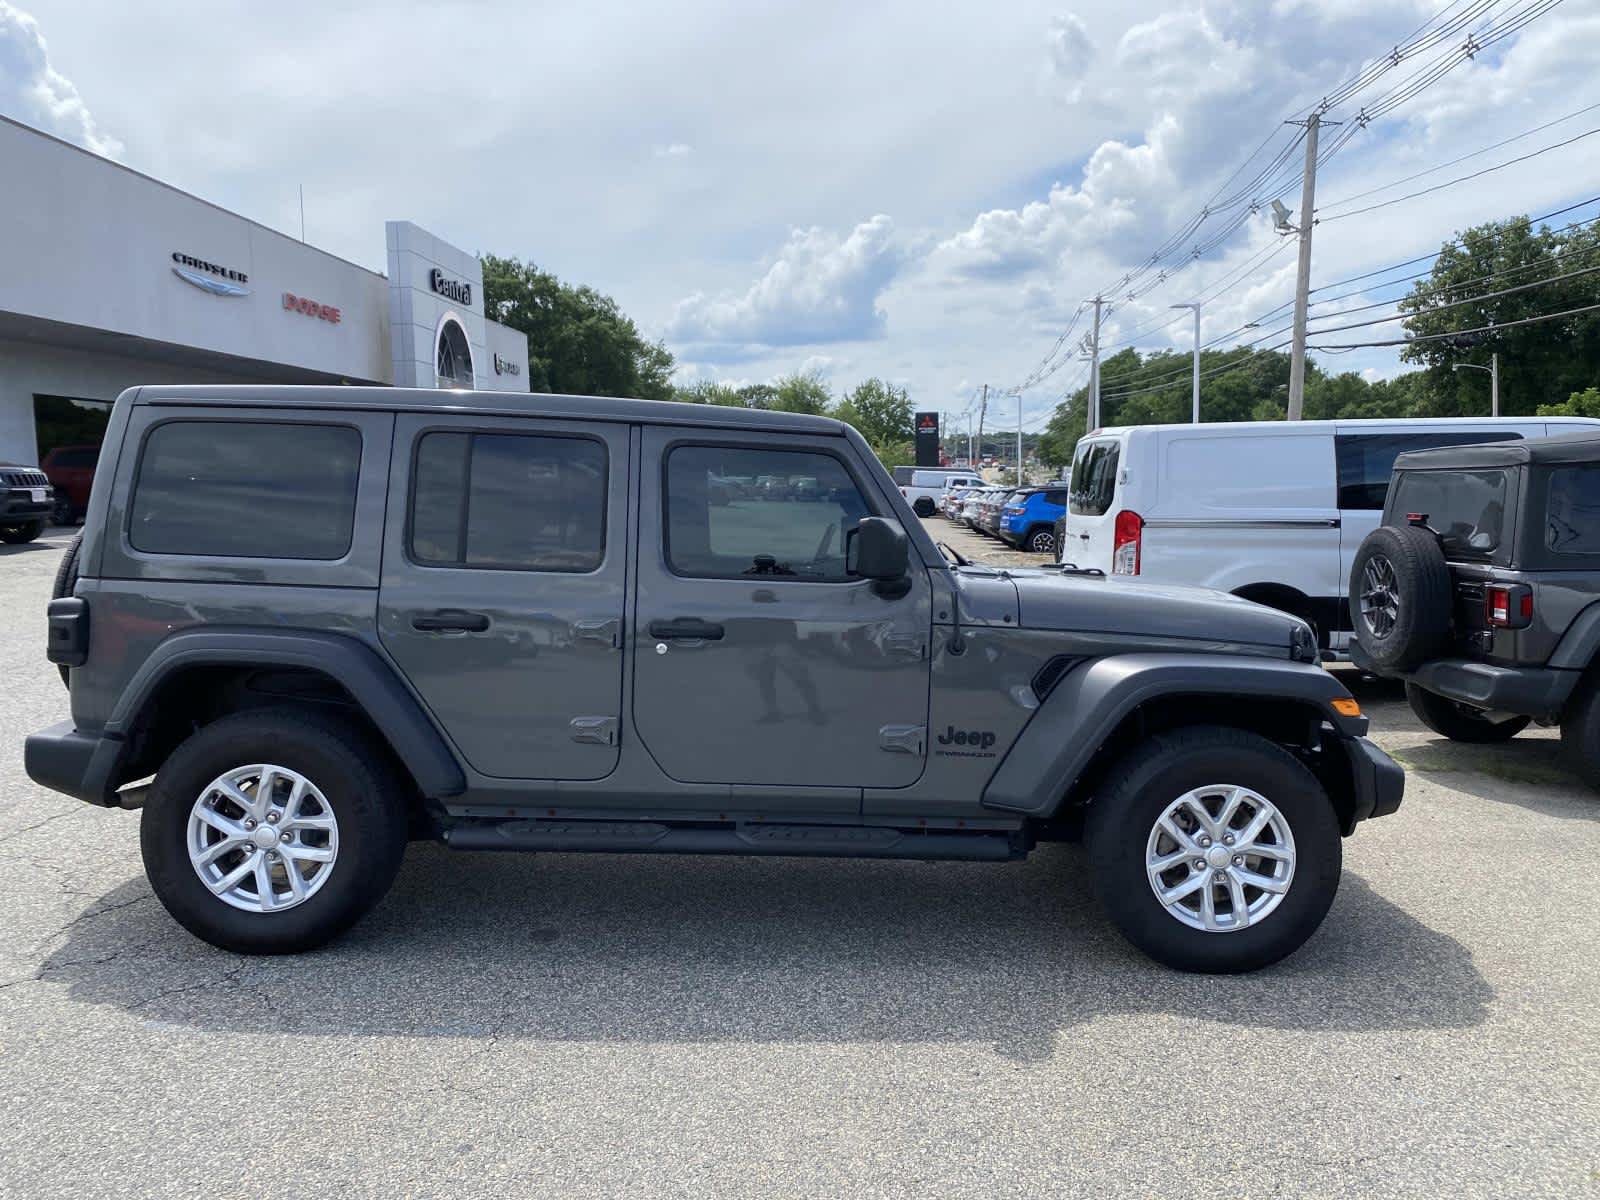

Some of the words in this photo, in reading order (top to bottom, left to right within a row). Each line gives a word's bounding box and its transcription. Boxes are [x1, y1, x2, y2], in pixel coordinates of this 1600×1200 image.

[172, 252, 249, 283] CHRYSLER
[430, 268, 472, 305] Central
[282, 293, 341, 324] DODGE
[937, 726, 996, 749] Jeep
